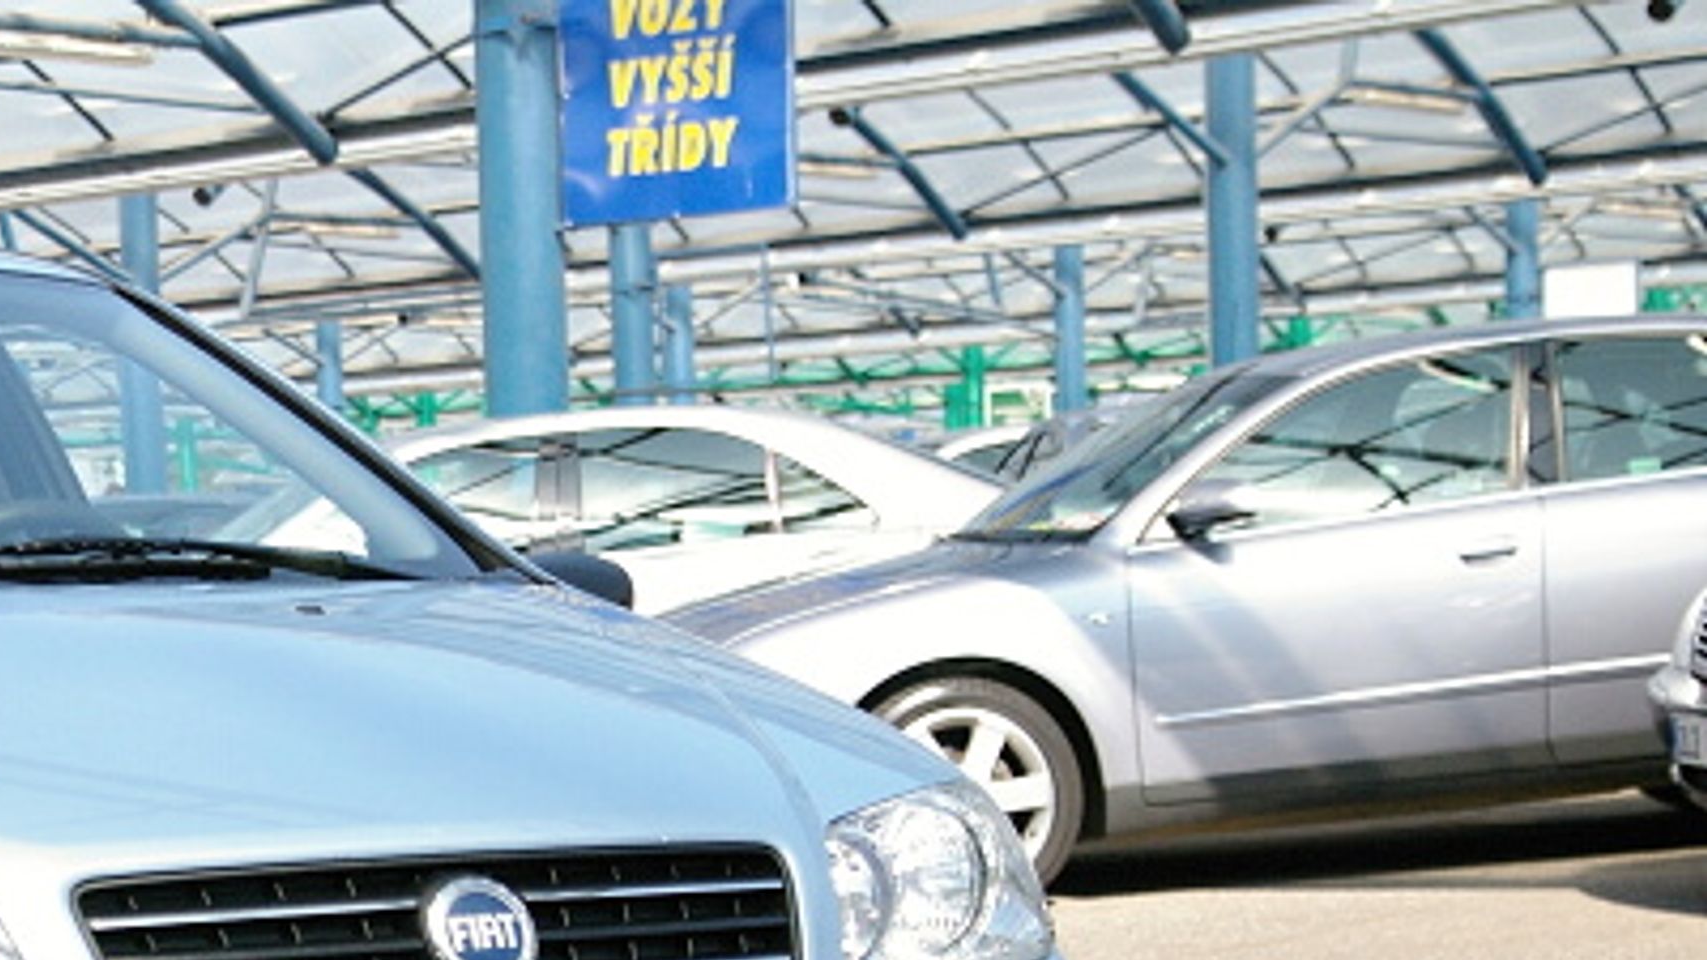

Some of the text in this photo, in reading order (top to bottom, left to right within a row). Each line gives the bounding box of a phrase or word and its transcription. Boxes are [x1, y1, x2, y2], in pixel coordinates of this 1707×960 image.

[608, 34, 736, 108] VYŠŠÍ
[606, 110, 738, 177] TŘÍDY
[448, 912, 520, 953] FIAT
